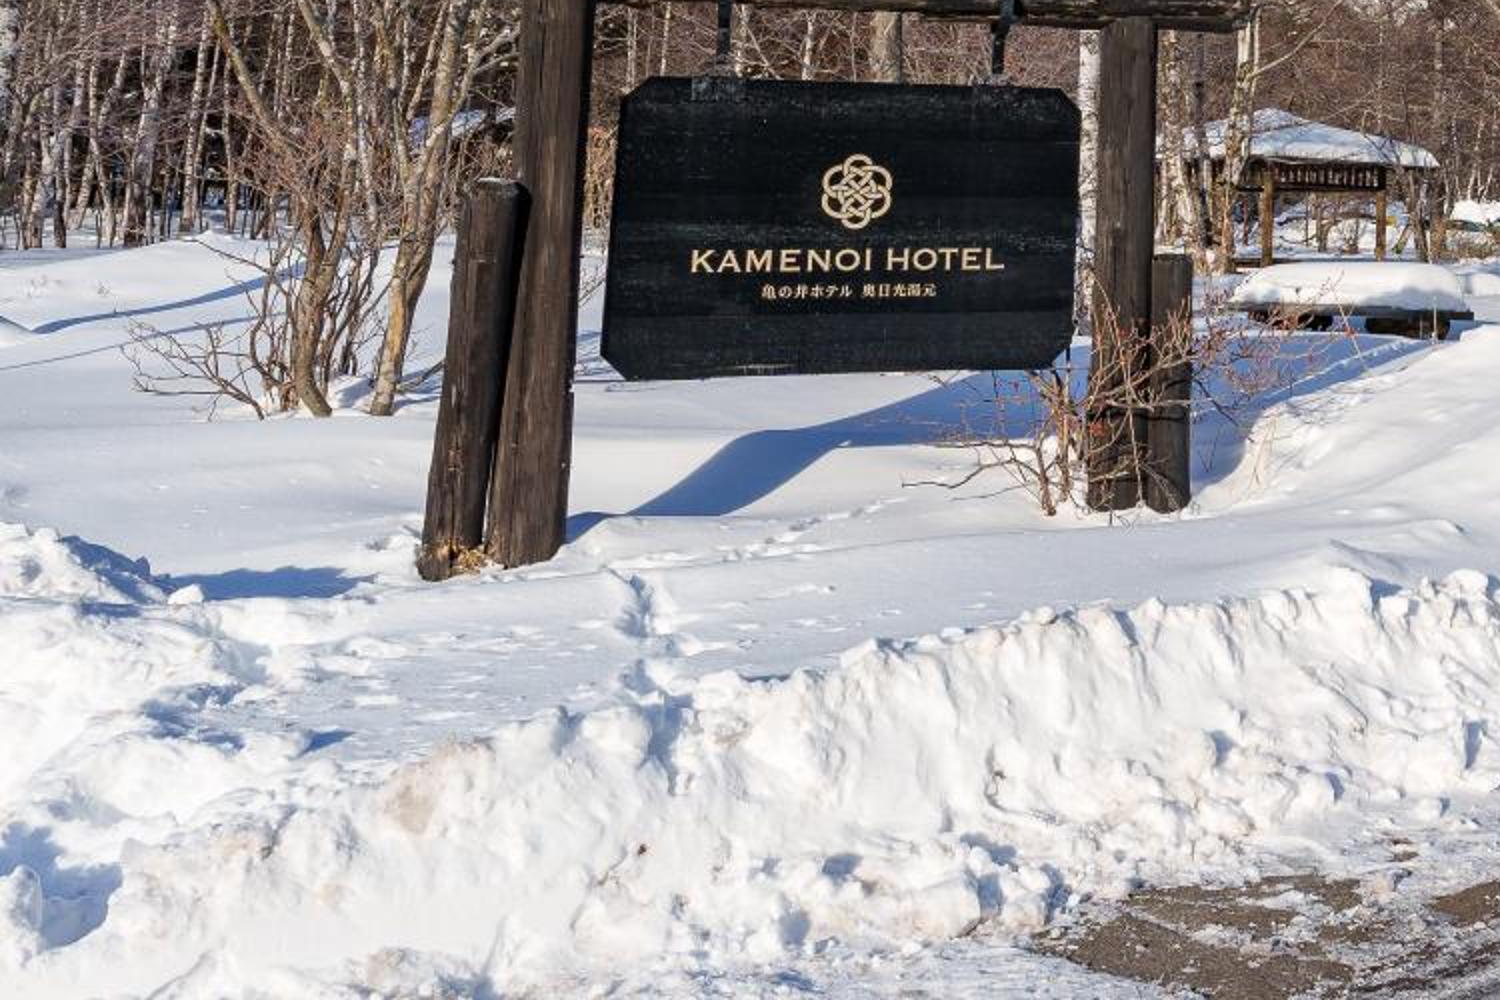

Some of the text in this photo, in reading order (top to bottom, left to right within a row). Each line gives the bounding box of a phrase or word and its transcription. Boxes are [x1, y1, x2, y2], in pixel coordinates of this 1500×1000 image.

[690, 247, 1005, 273] KAMENOI HOTEL
[761, 284, 937, 299] 亀の井ホテル 奥日光湯元
